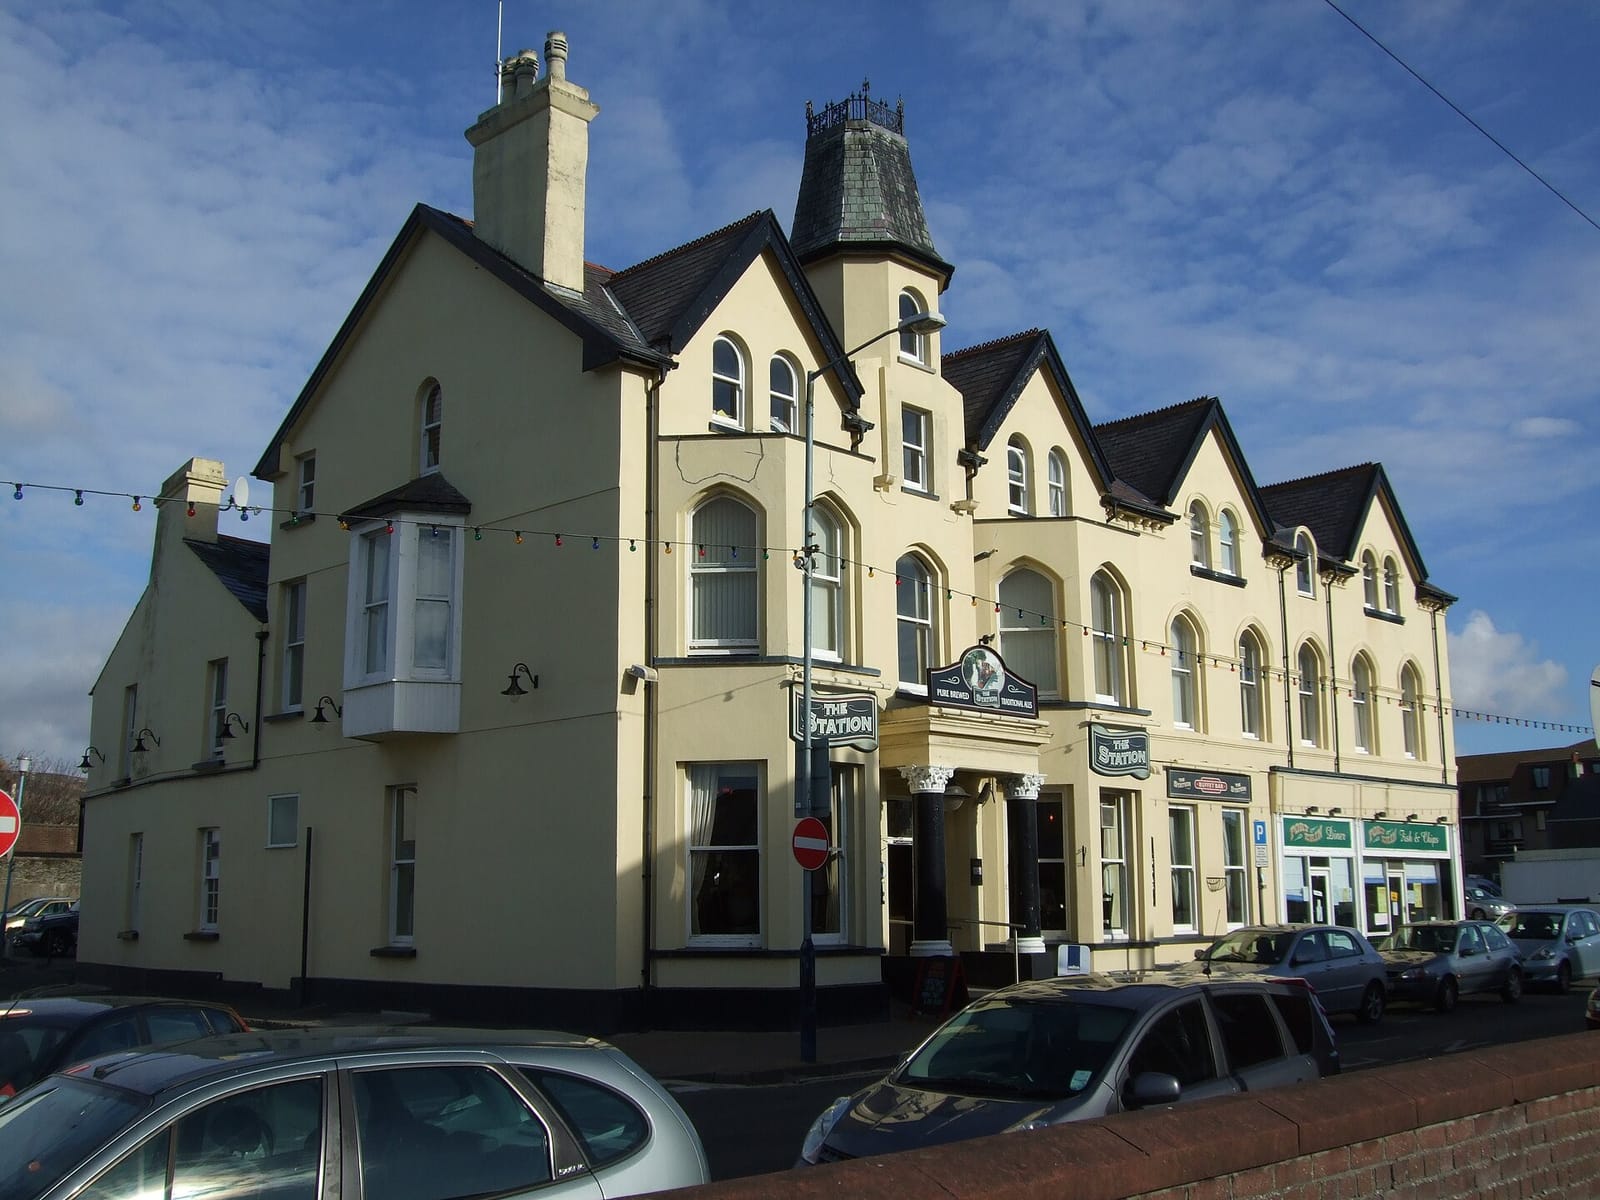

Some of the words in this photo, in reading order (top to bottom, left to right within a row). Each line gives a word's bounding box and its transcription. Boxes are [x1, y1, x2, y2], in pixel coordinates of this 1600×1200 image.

[937, 688, 950, 698] PURE
[950, 690, 970, 700] BREWED
[1001, 697, 1023, 707] TRADITIONAL
[823, 703, 848, 716] THE
[1112, 739, 1130, 750] THE
[1098, 745, 1146, 766] STATION
[1256, 824, 1264, 841] P
[1399, 829, 1412, 843] Fish
[1414, 831, 1421, 843] &
[1421, 831, 1440, 848] Chips
